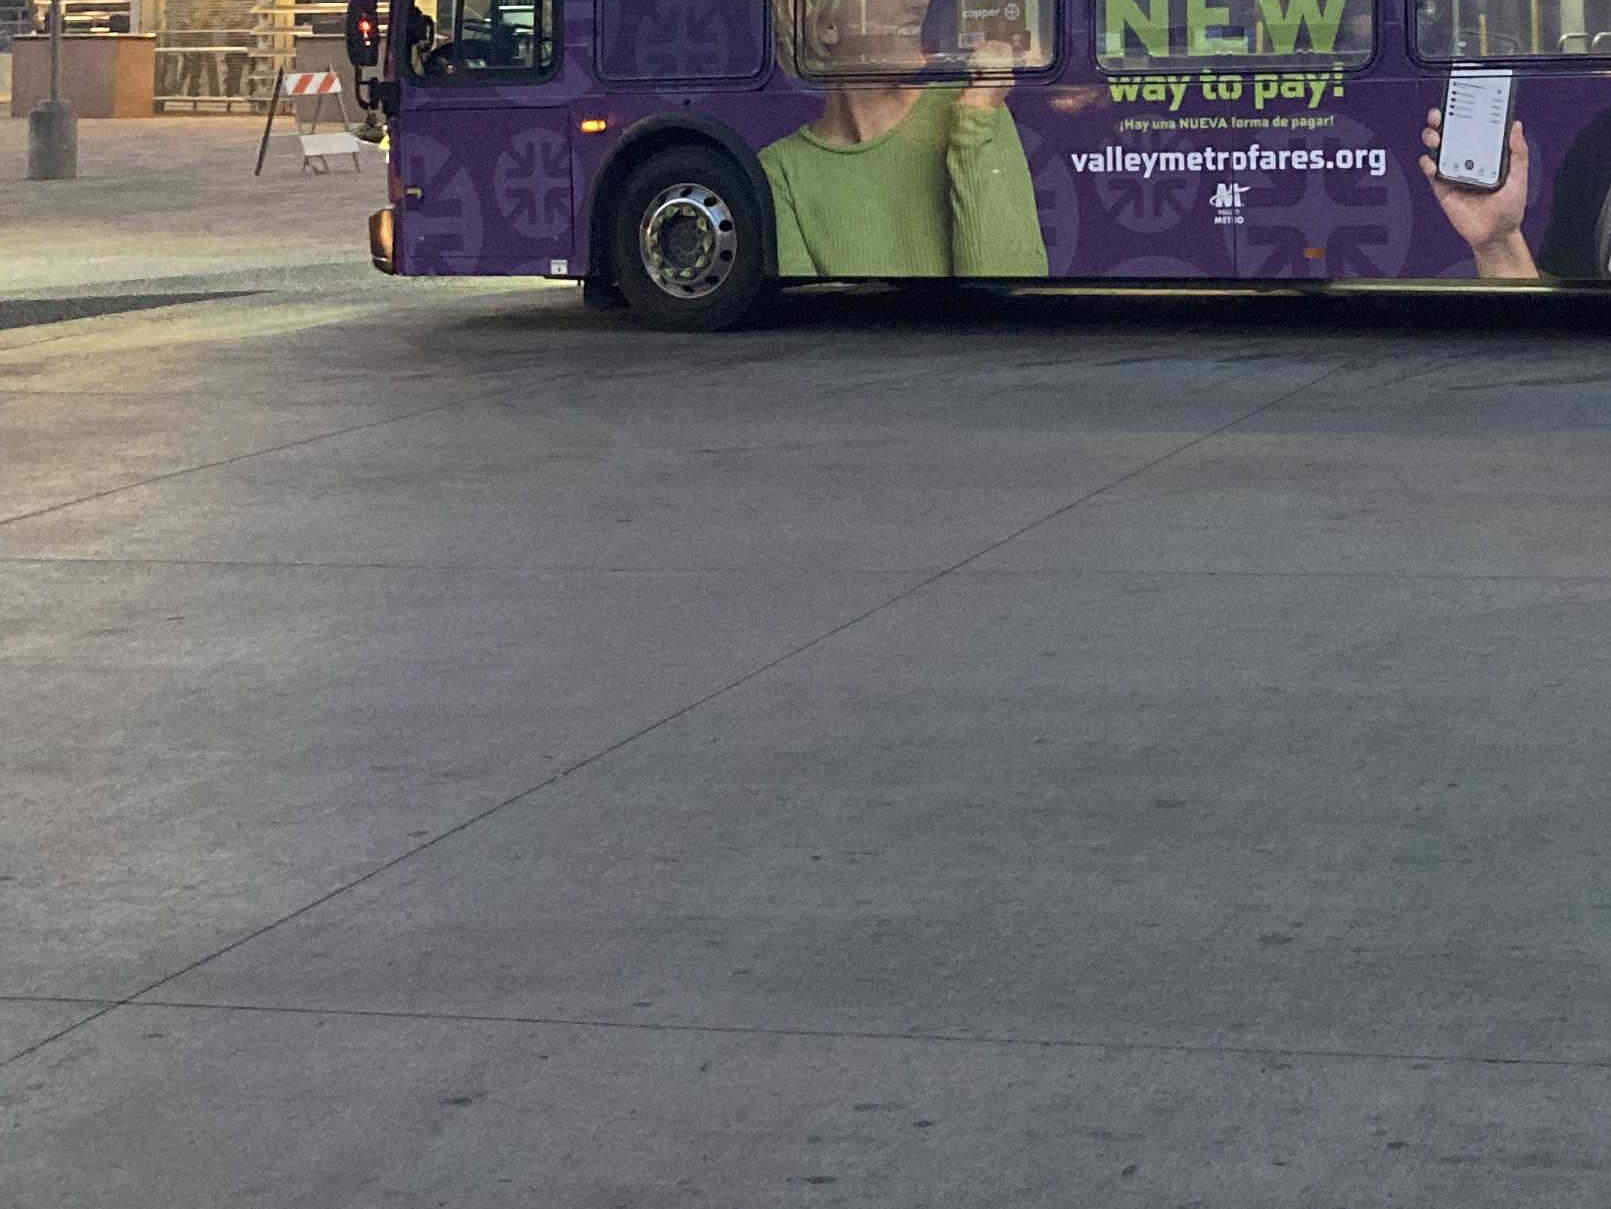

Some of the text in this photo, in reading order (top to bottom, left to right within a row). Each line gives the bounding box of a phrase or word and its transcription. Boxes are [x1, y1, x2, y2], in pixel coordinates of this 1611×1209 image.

[1108, 61, 1344, 111] way to pay!
[1120, 115, 1334, 132] ¡Hay una NUEVA forma de pagar!
[1071, 144, 1387, 178] valleymetrofares.org
